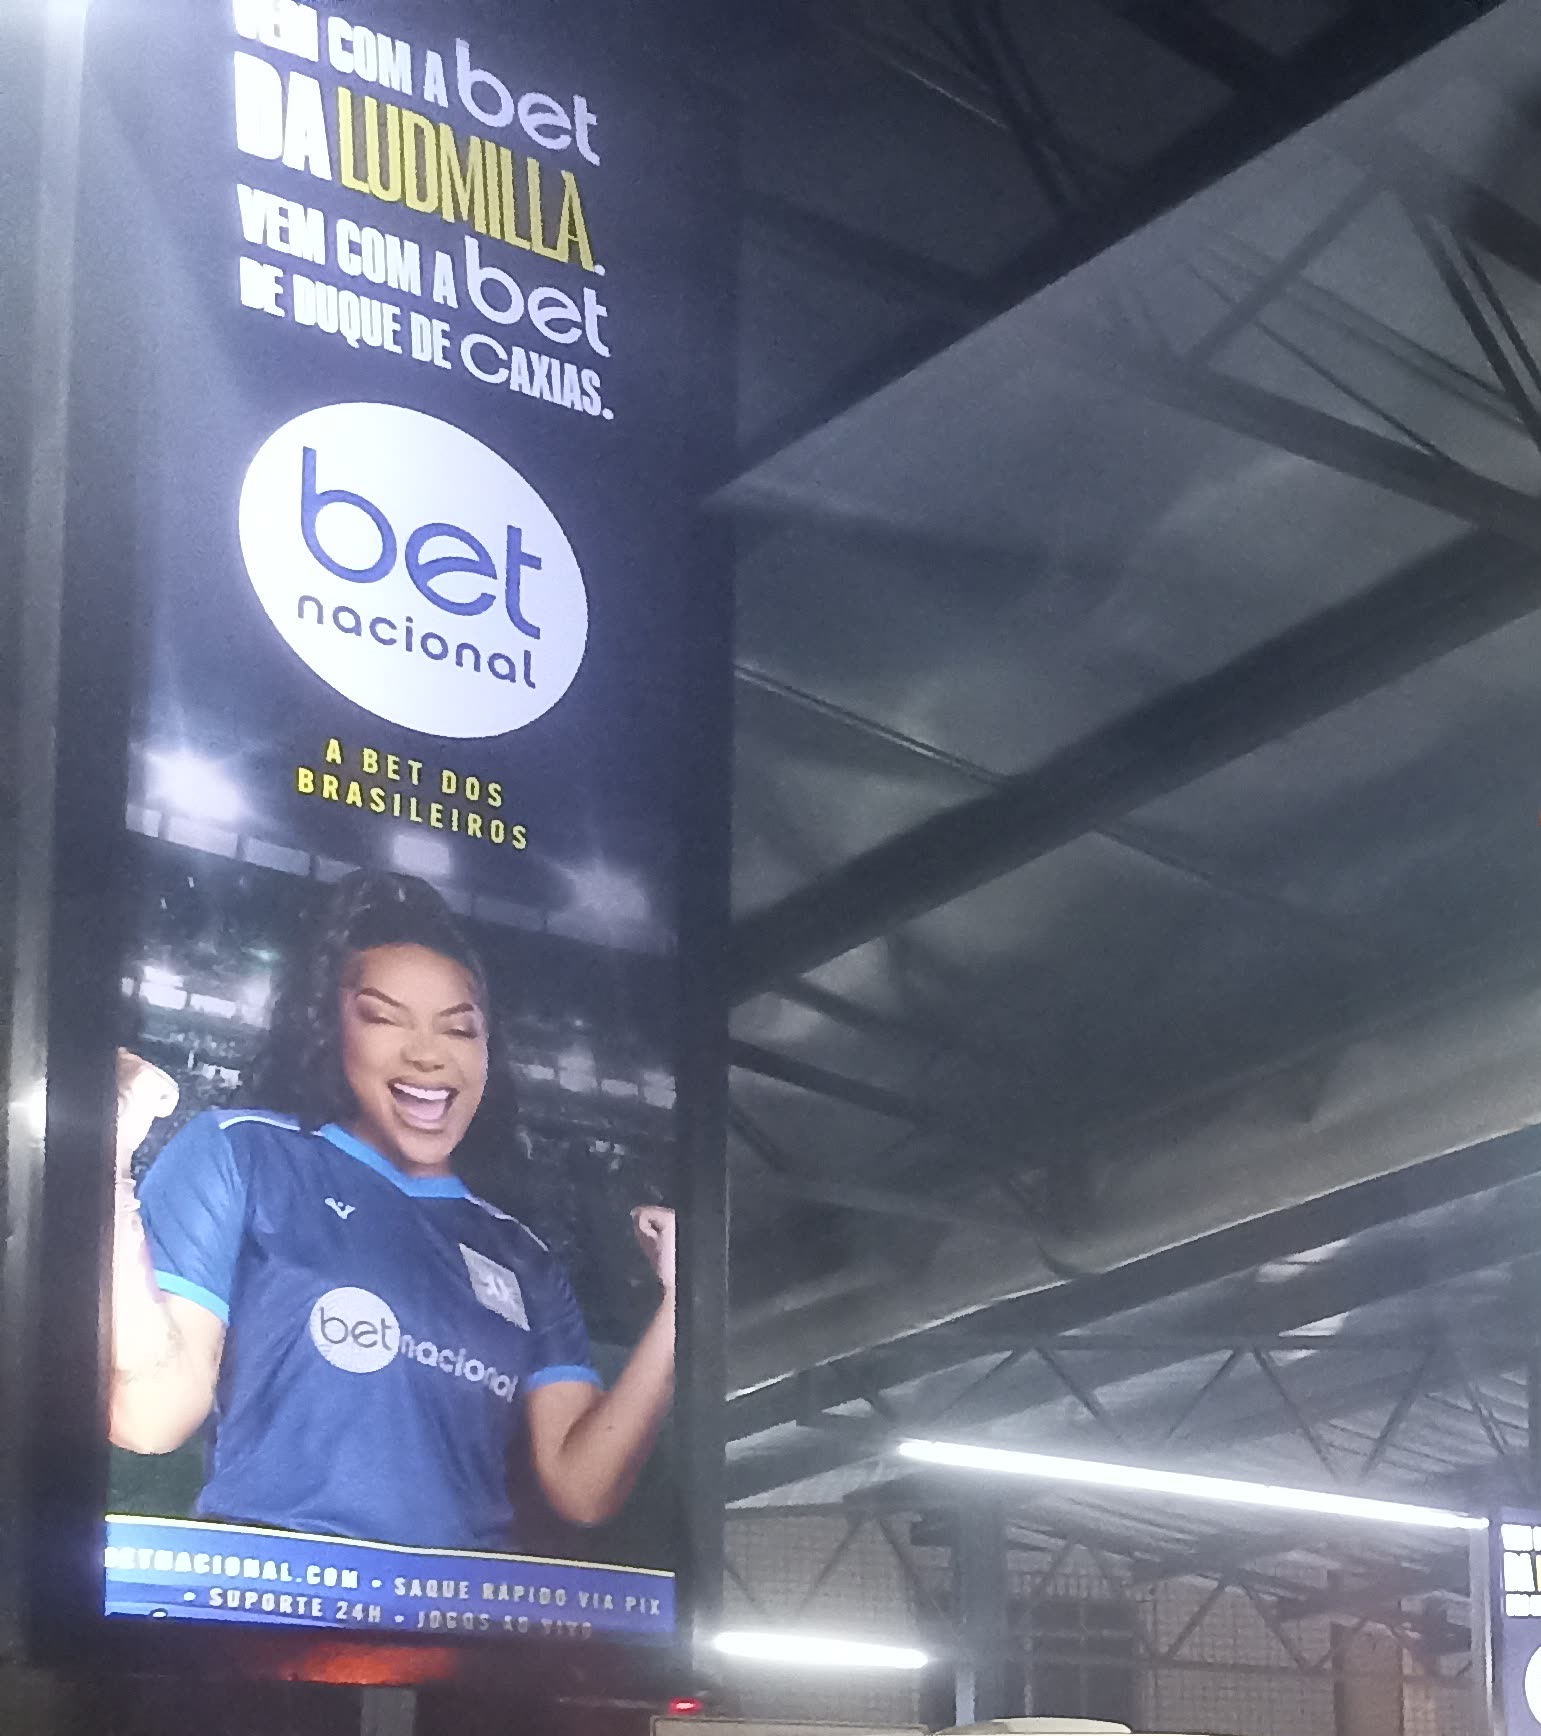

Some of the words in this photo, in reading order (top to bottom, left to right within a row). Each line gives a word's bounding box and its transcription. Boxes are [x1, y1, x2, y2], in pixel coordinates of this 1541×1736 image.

[233, 50, 333, 181] DA
[327, 16, 413, 96] COM
[423, 49, 449, 109] A
[455, 38, 601, 166] bet
[236, 184, 327, 265] VEM
[336, 210, 423, 296] COM
[432, 251, 459, 309] A
[464, 236, 612, 358] bet
[239, 257, 285, 318] DE
[292, 278, 403, 354] DUQUE
[410, 314, 453, 371] DE
[461, 331, 615, 420] CAXIAS.
[299, 446, 543, 641] bet
[297, 592, 538, 691] nacional
[297, 767, 529, 851] BRASILEIROS
[325, 737, 343, 766] A
[362, 748, 424, 789] BET
[442, 769, 505, 808] DOS
[320, 1307, 393, 1351] bet
[400, 1334, 520, 1404] nacional
[208, 1587, 324, 1618] SUPORTE
[335, 1601, 382, 1623] 24H
[416, 1610, 491, 1632] JOGOS
[393, 1576, 470, 1600] SAQUE
[578, 1591, 614, 1610] VIA
[625, 1595, 661, 1616] PIX
